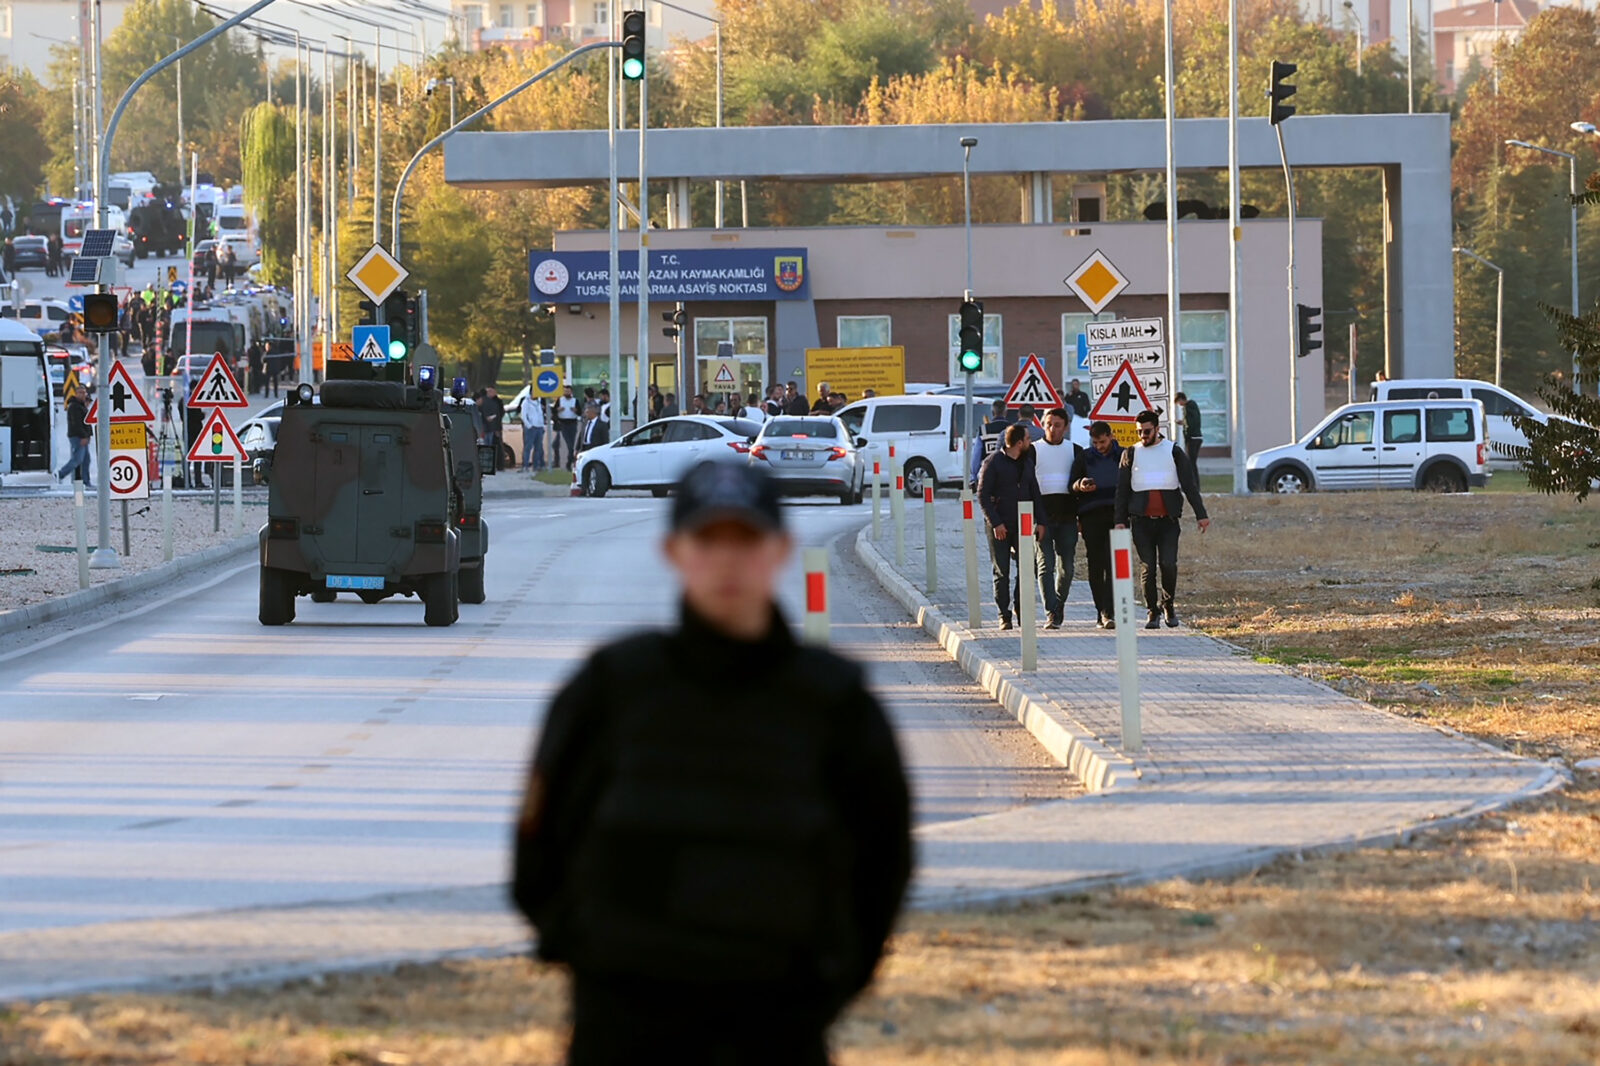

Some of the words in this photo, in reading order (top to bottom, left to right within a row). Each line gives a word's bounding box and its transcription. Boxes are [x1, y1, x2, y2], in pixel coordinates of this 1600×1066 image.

[661, 255, 680, 265] T.C.
[577, 270, 679, 281] KAHRMANAZAN
[681, 267, 765, 280] KAYMAKAMLIĞI
[678, 282, 718, 295] ASAYİŞ
[719, 283, 768, 294] NOKTASI
[1090, 328, 1117, 341] KIŞLA
[1121, 326, 1144, 339] MAH.
[113, 466, 133, 481] 30
